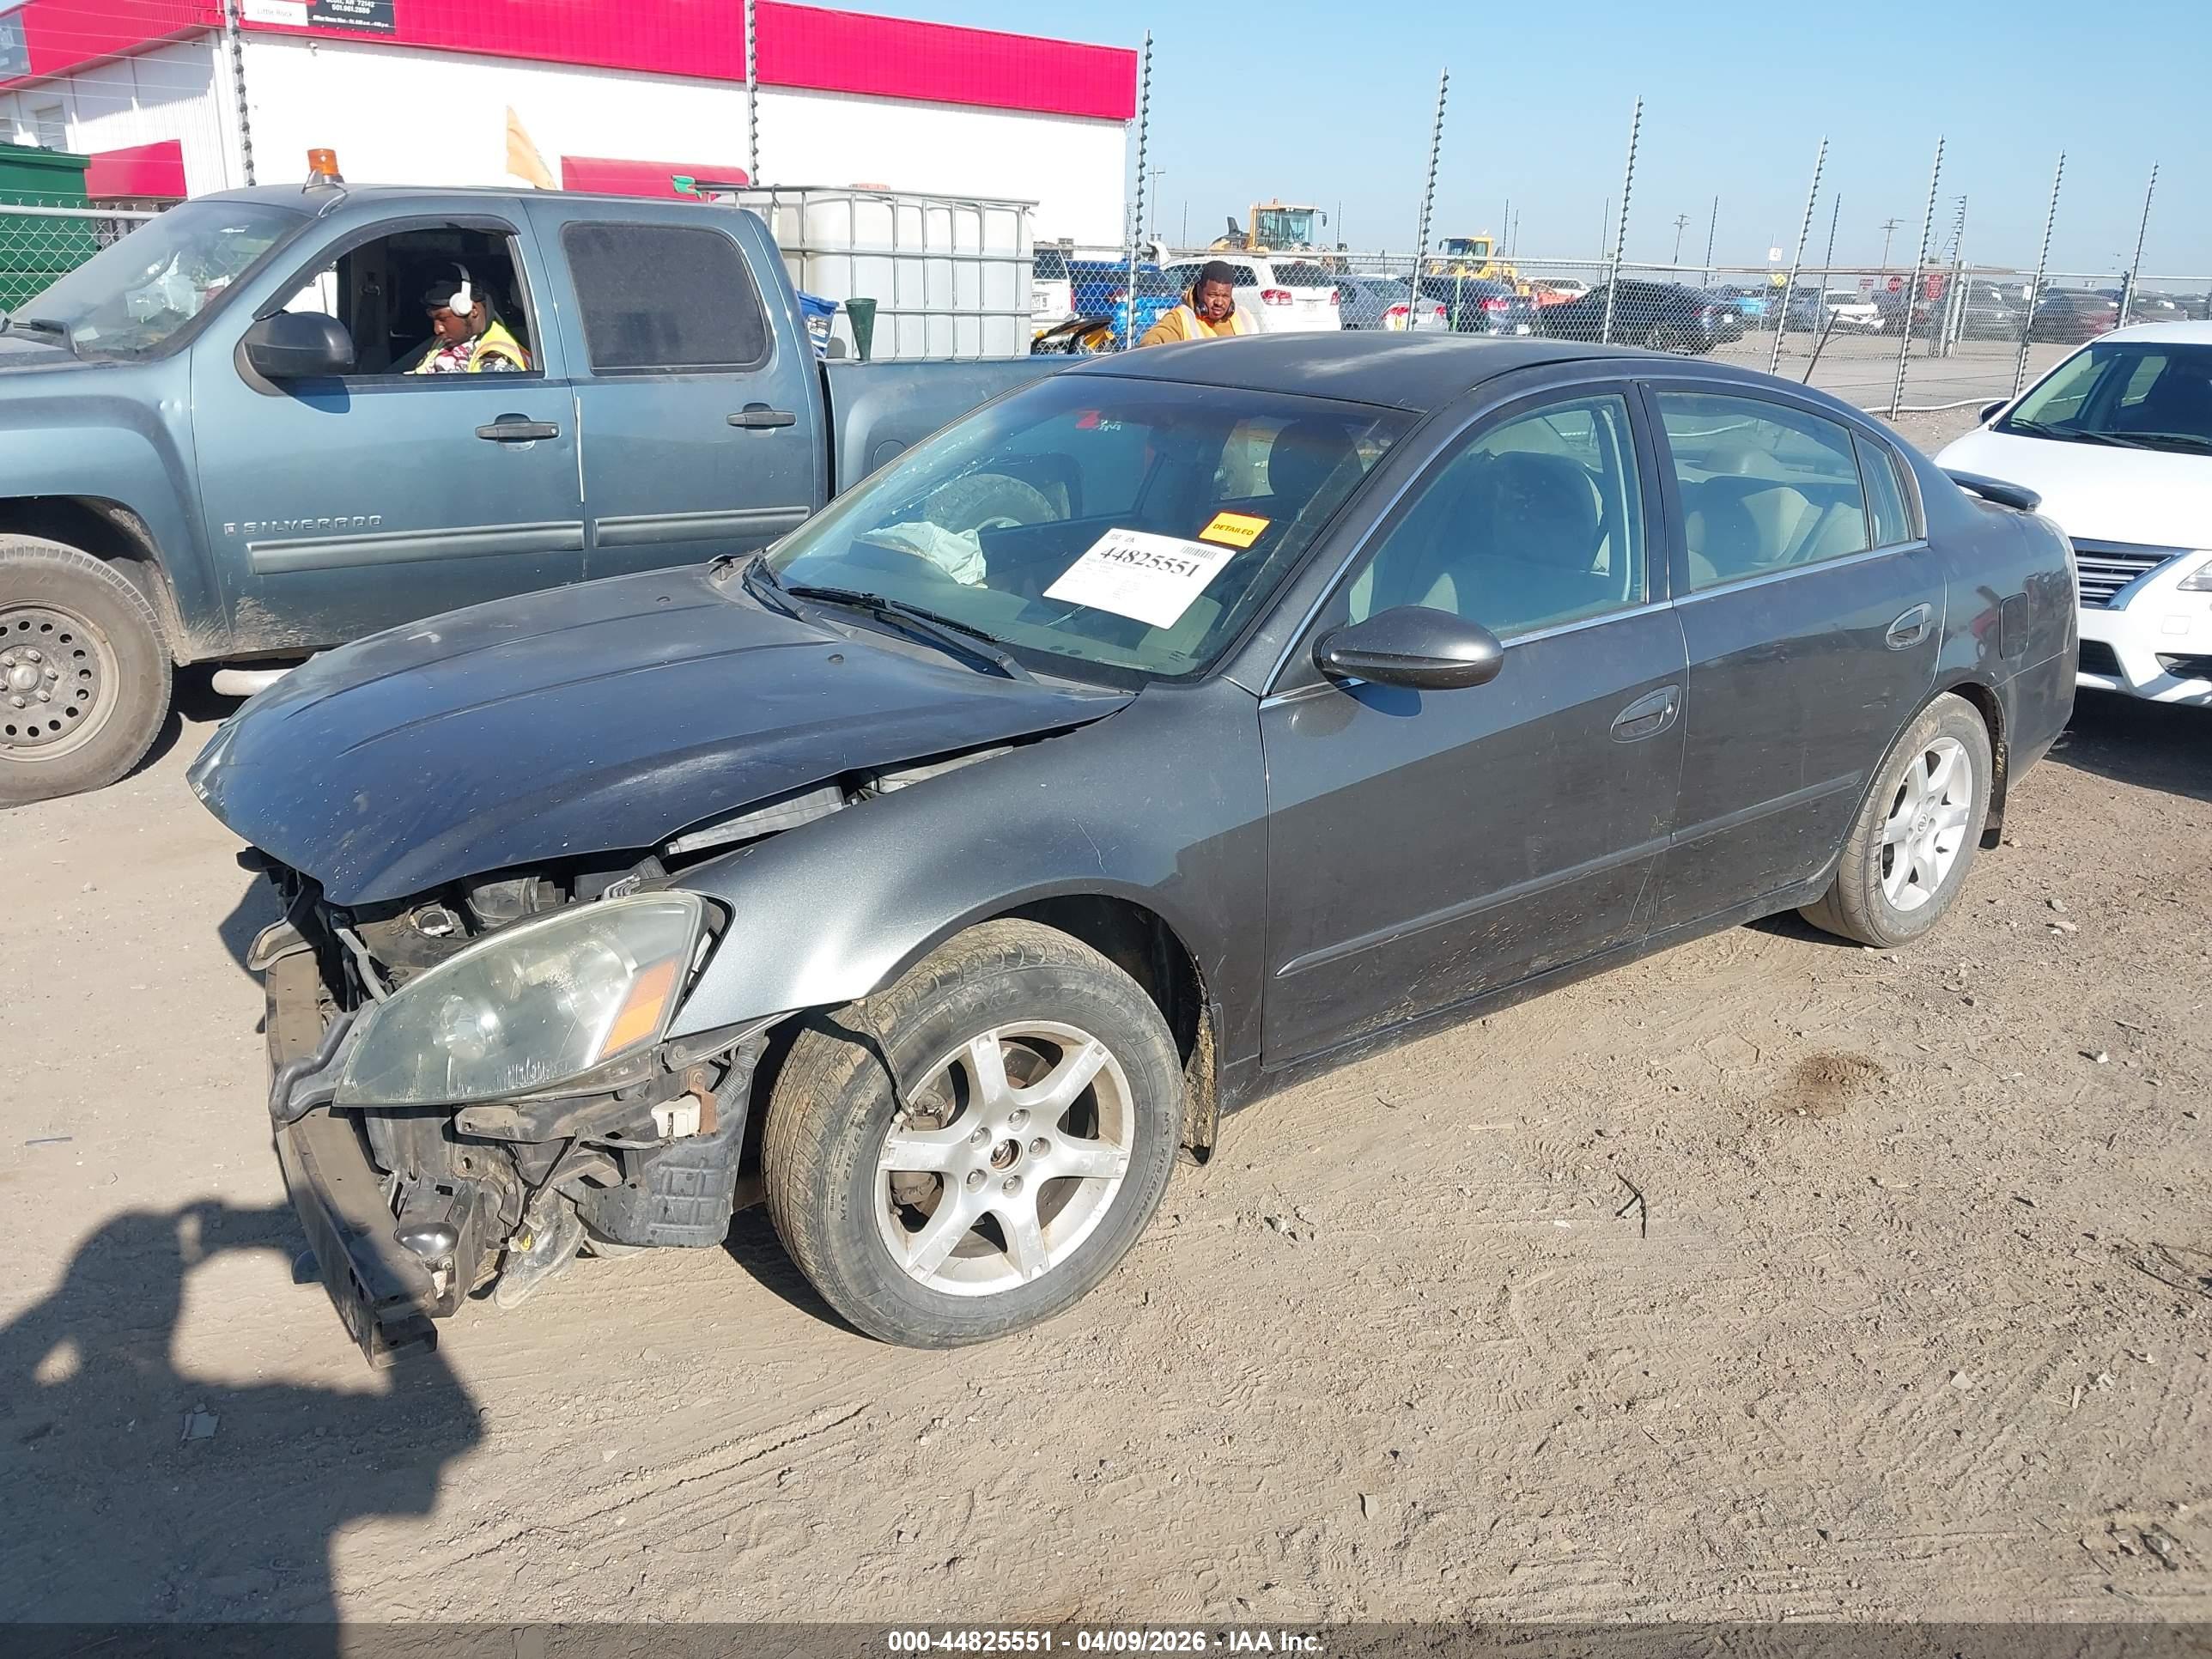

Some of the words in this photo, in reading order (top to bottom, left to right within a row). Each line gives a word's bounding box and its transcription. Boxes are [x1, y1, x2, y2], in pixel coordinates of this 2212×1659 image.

[244, 515, 382, 533] SILVERADO
[1212, 524, 1255, 536] DETAILED
[1100, 547, 1200, 578] 44825551
